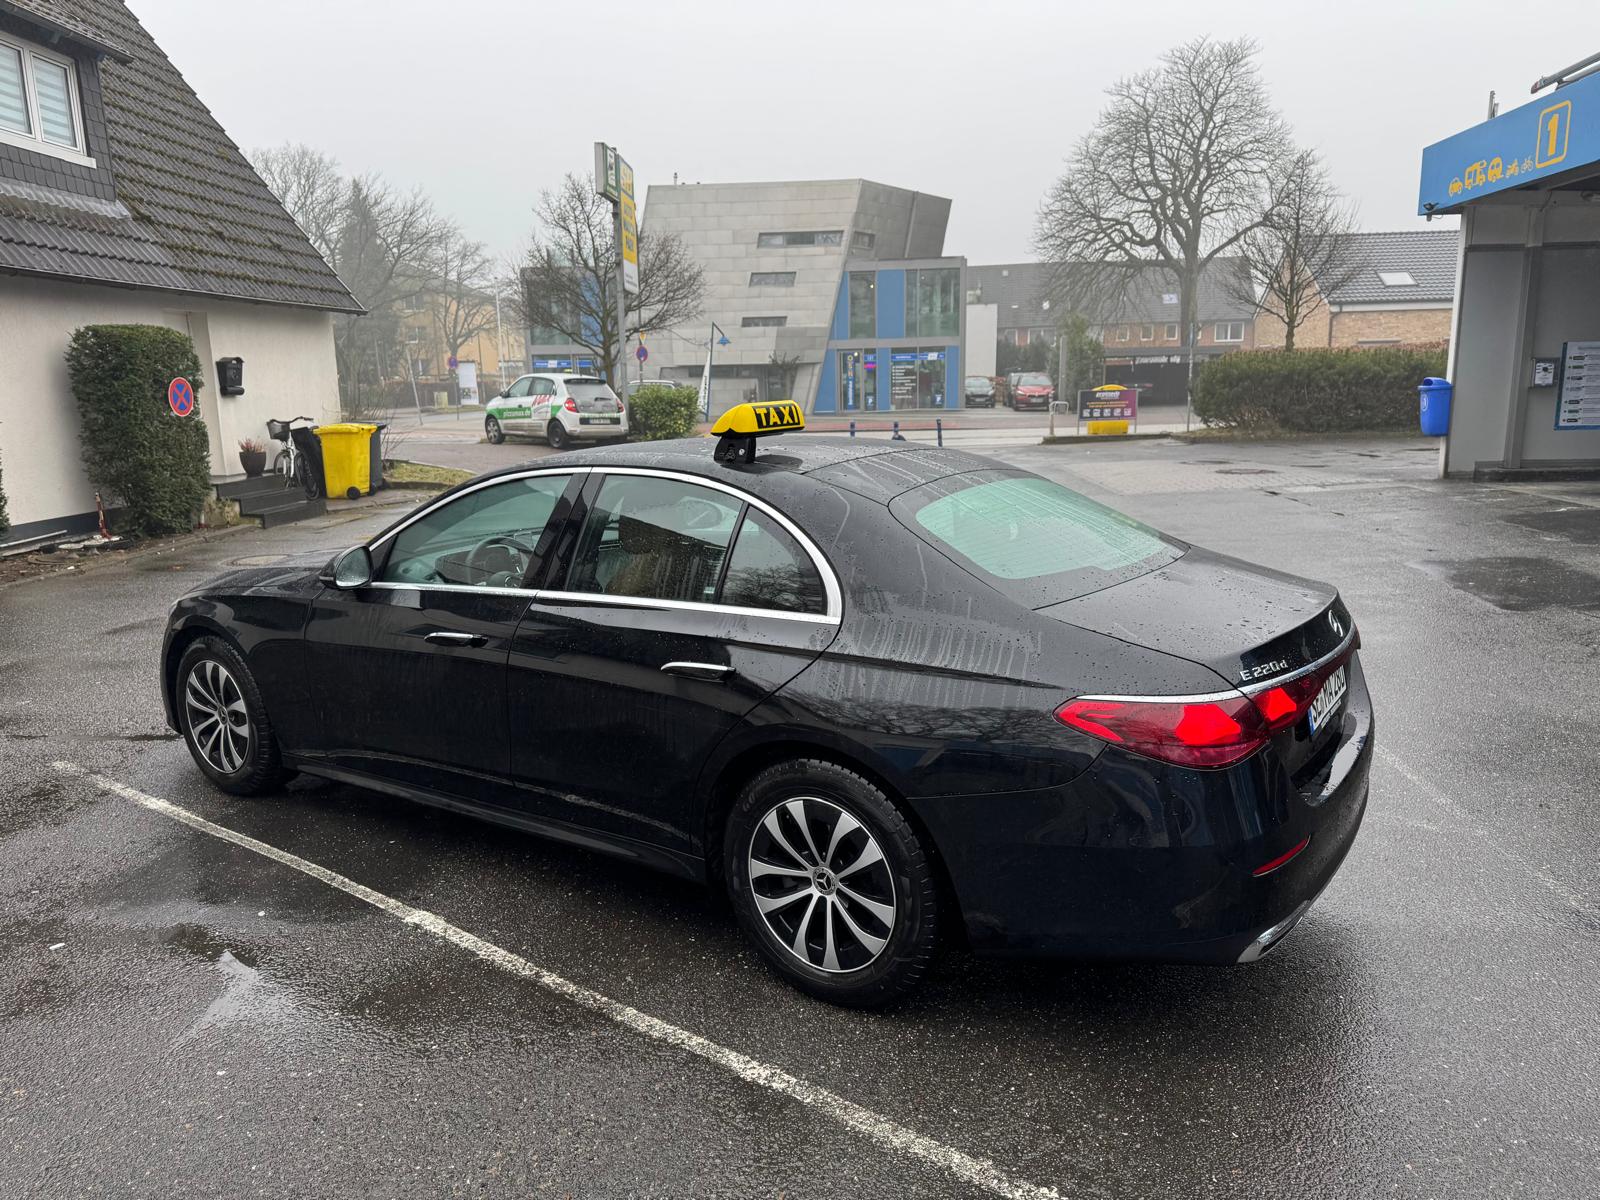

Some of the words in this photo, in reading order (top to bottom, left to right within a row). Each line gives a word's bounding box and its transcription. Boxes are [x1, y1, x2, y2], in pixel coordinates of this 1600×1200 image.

[1548, 113, 1559, 156] 1
[756, 406, 798, 426] TAXI
[1240, 671, 1251, 681] E
